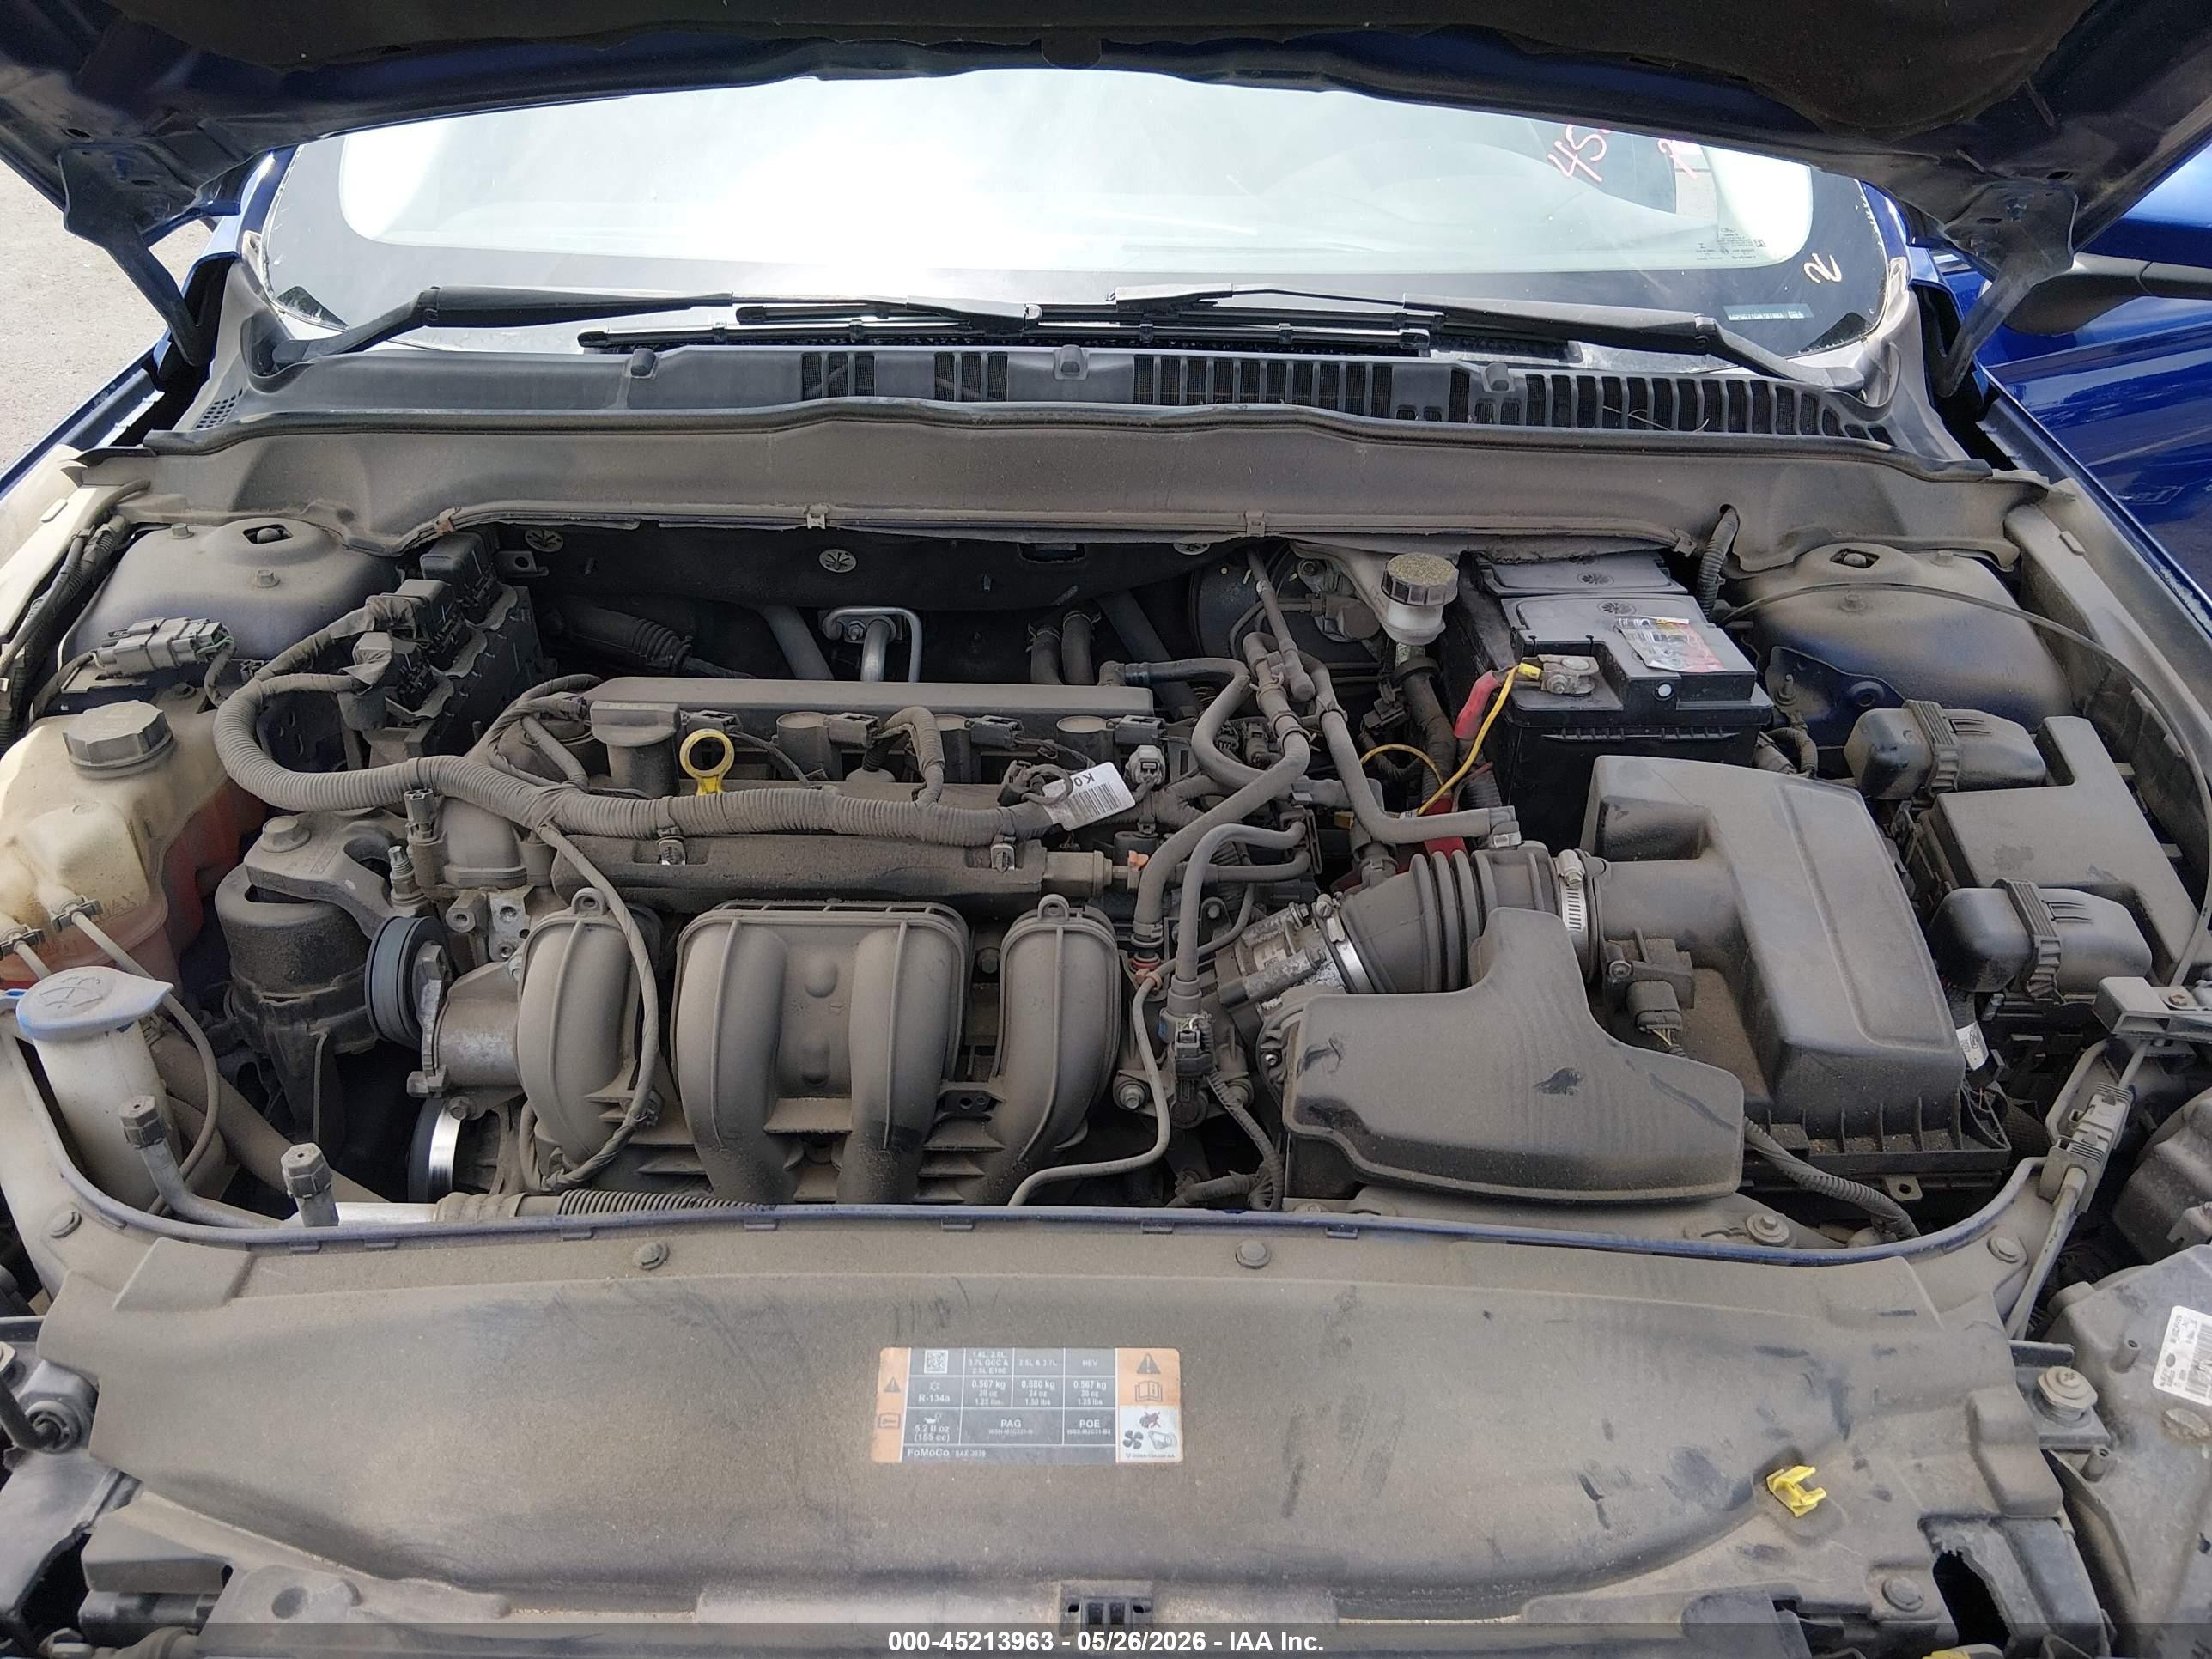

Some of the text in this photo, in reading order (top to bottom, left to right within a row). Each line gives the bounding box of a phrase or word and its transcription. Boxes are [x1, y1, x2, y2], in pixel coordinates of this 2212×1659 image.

[971, 1379, 1006, 1391] 0.567 kg
[1021, 1379, 1055, 1391] 0.680 kg
[1073, 1380, 1107, 1391] 0.567 kg
[918, 1394, 951, 1403] R-134a
[1000, 1419, 1022, 1428] PAG
[1079, 1419, 1101, 1429] POE
[935, 1433, 951, 1443] cc)
[907, 1448, 950, 1457] FoMoCo
